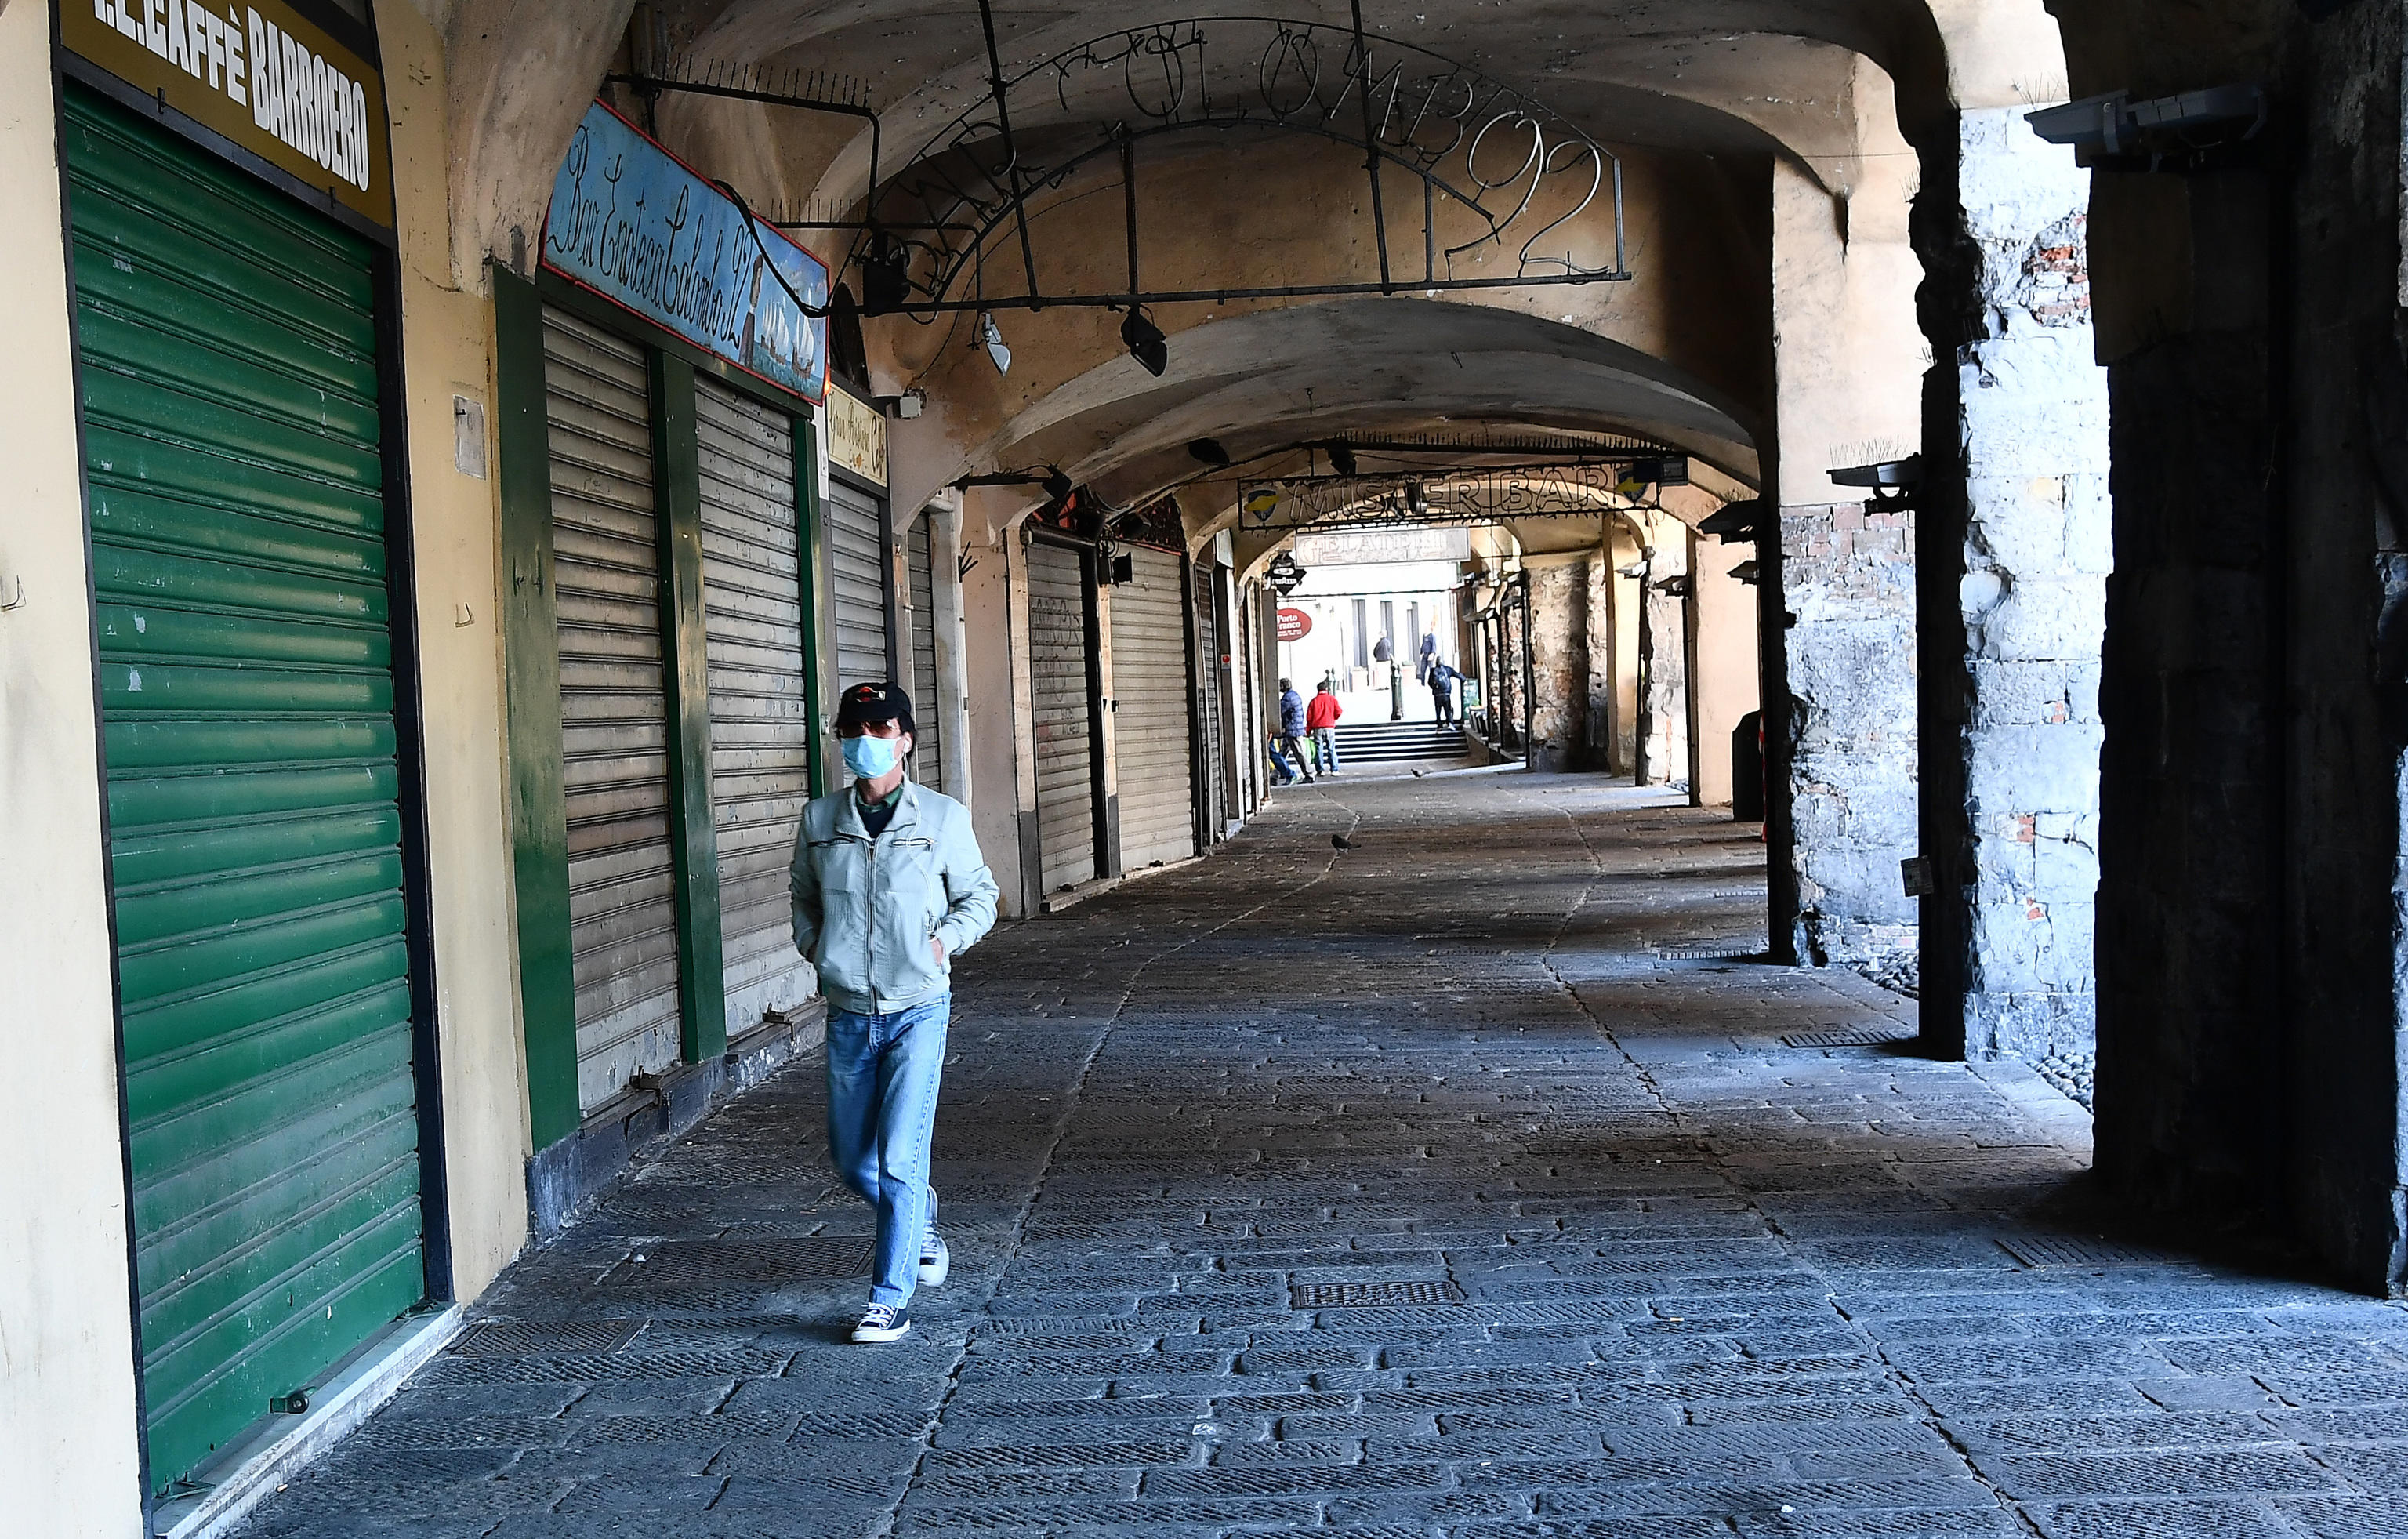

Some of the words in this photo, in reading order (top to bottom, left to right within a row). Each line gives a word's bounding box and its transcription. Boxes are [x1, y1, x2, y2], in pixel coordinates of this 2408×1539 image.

[247, 5, 370, 192] BARROERO
[546, 124, 599, 267] Bar
[662, 184, 723, 336] Colombo
[1290, 476, 1481, 521] MISTER
[1499, 466, 1609, 514] BAR
[1277, 614, 1298, 623] Porto
